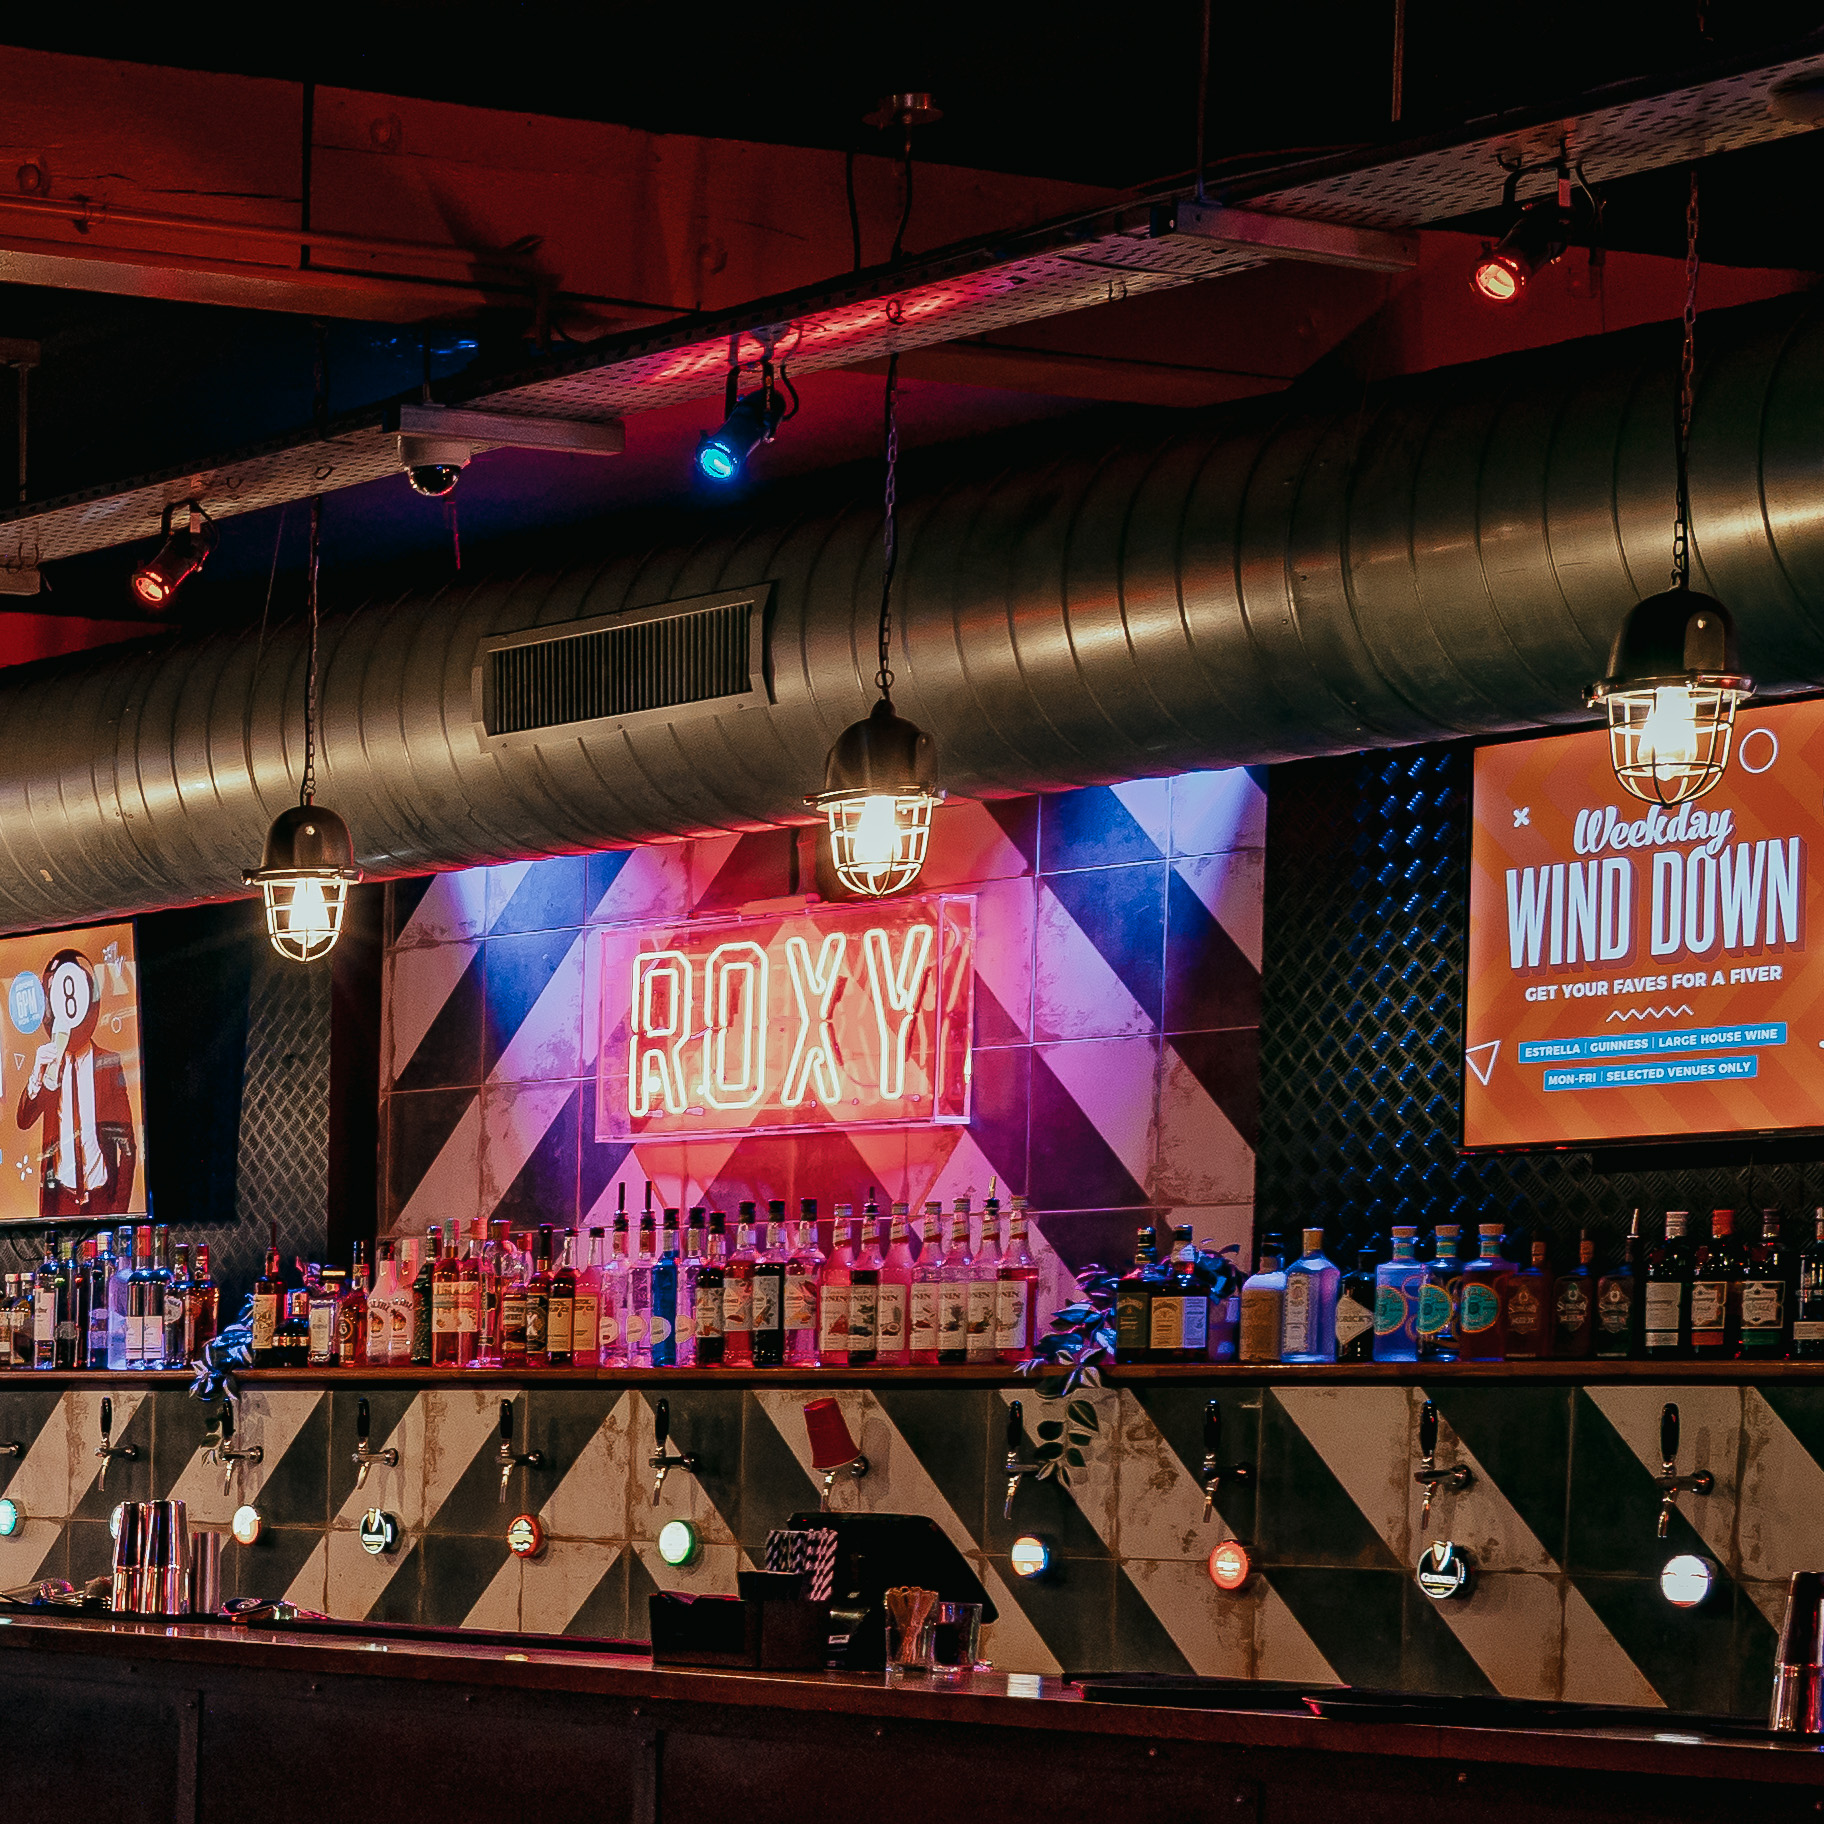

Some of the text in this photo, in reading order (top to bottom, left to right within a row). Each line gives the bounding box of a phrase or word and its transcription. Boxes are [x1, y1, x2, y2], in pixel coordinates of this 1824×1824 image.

[1573, 801, 1733, 855] Weekday
[1506, 835, 1800, 969] WIND DOWN
[63, 975, 77, 1019] 8
[1525, 965, 1783, 1001] GET YOUR FAVES FOR A FIVER
[628, 924, 933, 1117] ROXY
[1525, 1029, 1778, 1058] ESTRELLA GUINNESS LARGE HOUSE WINE
[1547, 1061, 1751, 1085] MON-FRI SELECTED VENUES ONLY
